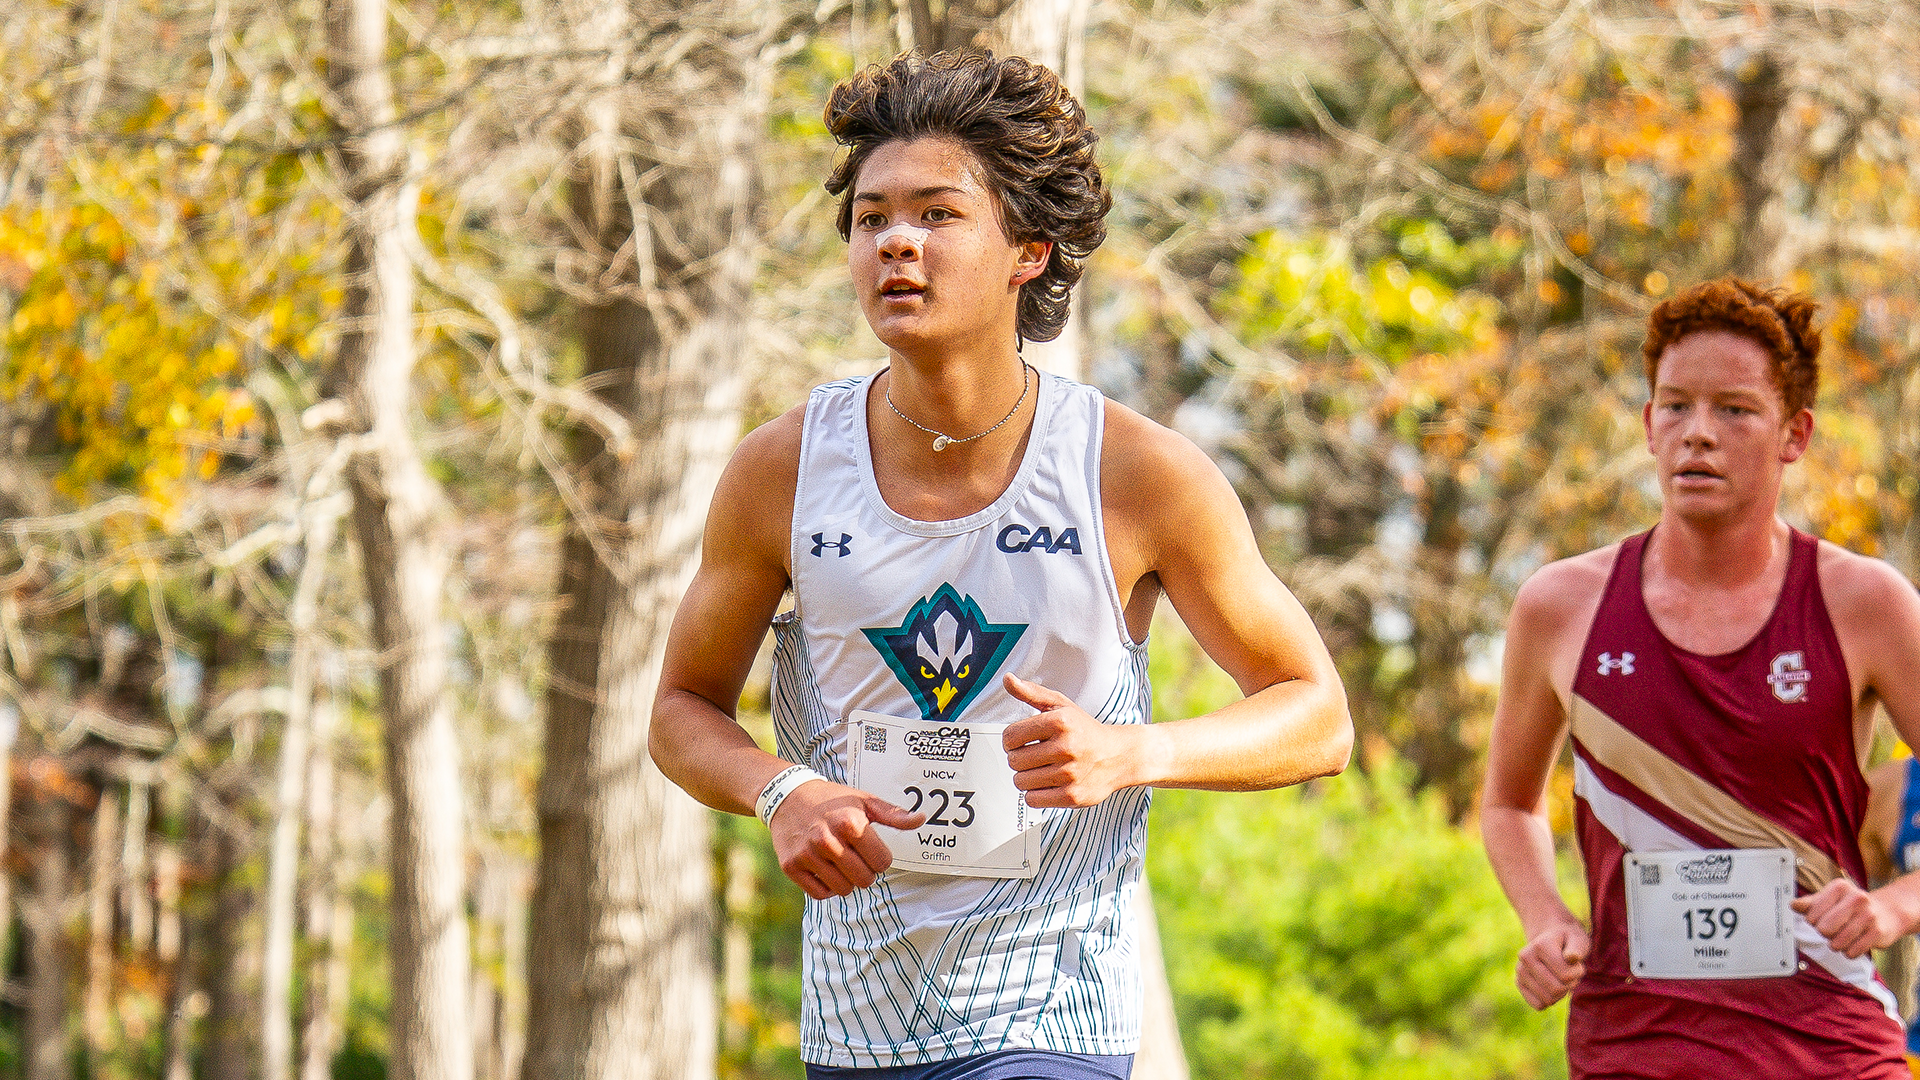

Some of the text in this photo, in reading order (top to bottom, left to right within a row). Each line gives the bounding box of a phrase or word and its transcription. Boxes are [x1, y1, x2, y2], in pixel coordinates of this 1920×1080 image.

[996, 523, 1082, 555] CAA
[904, 731, 966, 748] CROSS
[938, 727, 970, 738] CAA
[908, 745, 965, 757] COUNTRY
[923, 769, 957, 780] UNCW
[903, 786, 976, 828] 223
[917, 832, 956, 848] Wald
[921, 851, 951, 861] Griffin
[1683, 907, 1738, 940] 139
[1693, 946, 1728, 957] Miller
